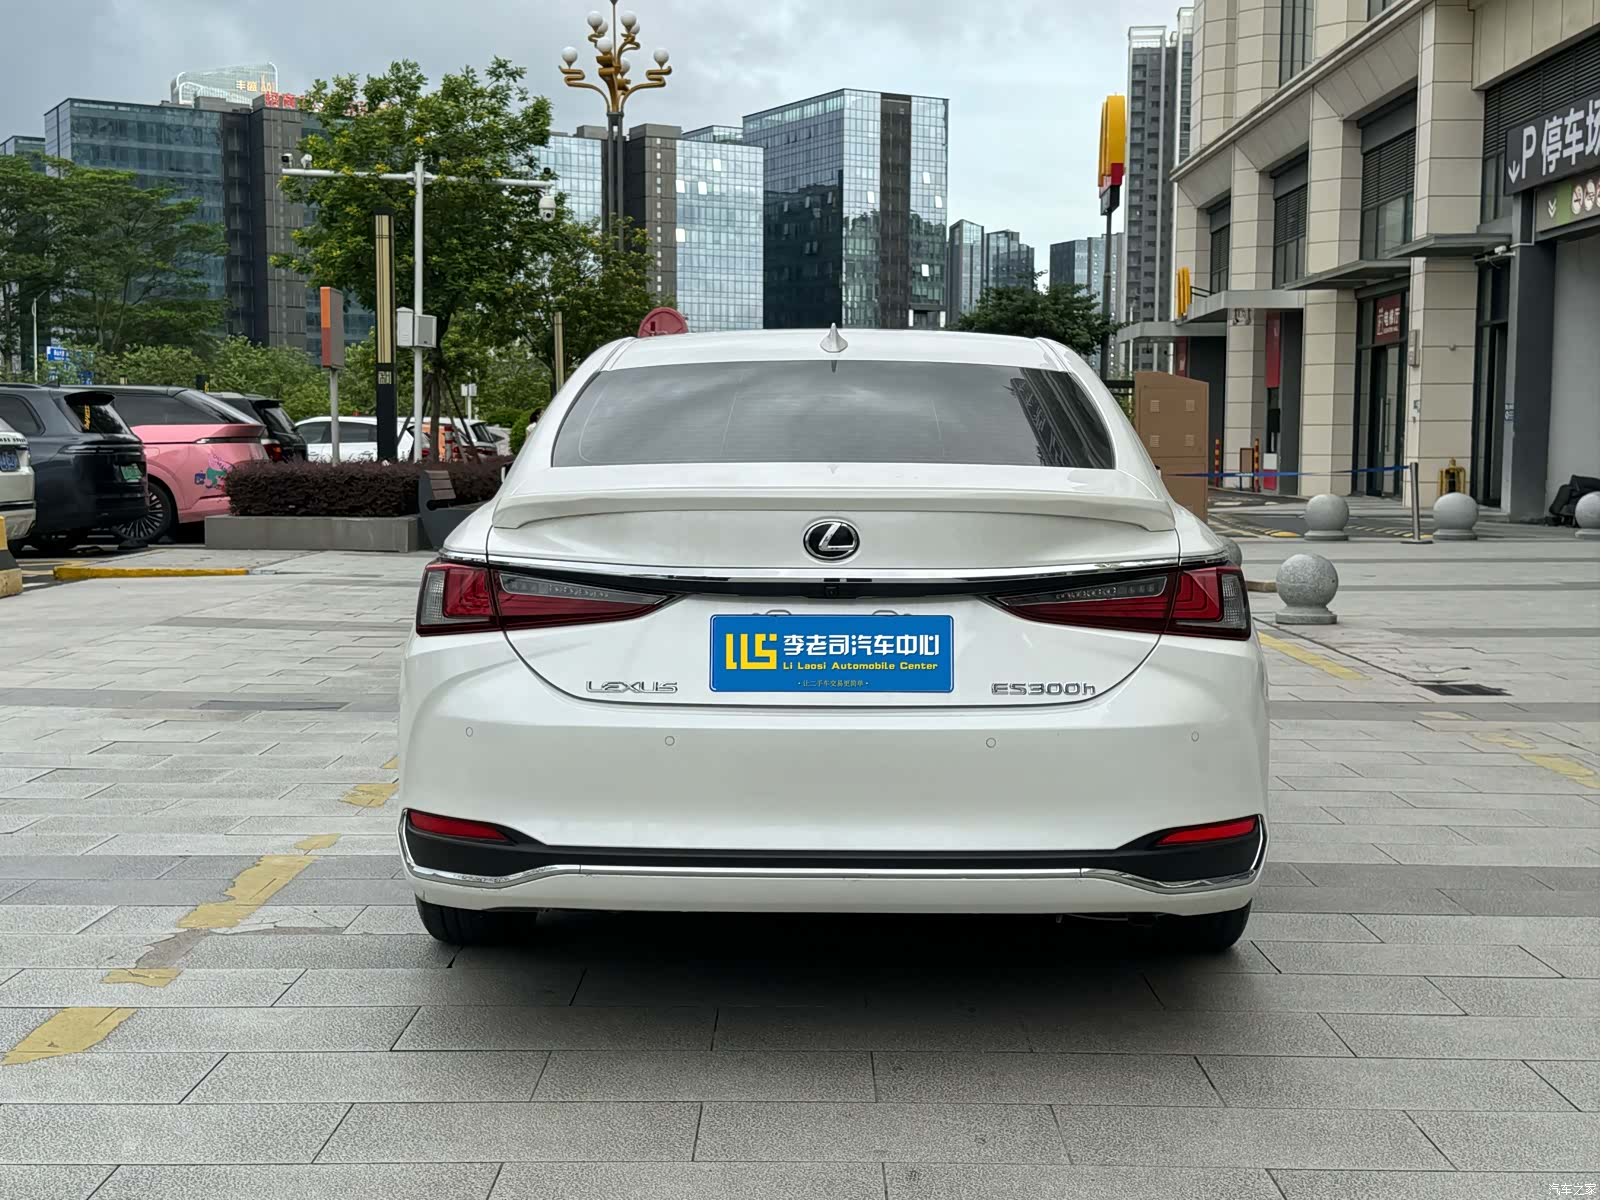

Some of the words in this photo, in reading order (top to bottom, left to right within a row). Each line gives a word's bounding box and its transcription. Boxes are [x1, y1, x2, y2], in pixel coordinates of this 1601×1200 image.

[1521, 125, 1537, 179] P
[783, 634, 940, 656] 李老司汽车中心
[783, 661, 793, 670] Li
[797, 661, 827, 670] Laosi
[831, 661, 896, 670] Automobile
[900, 661, 938, 670] Center
[586, 681, 678, 694] LEXUS
[991, 682, 1096, 696] ES300h
